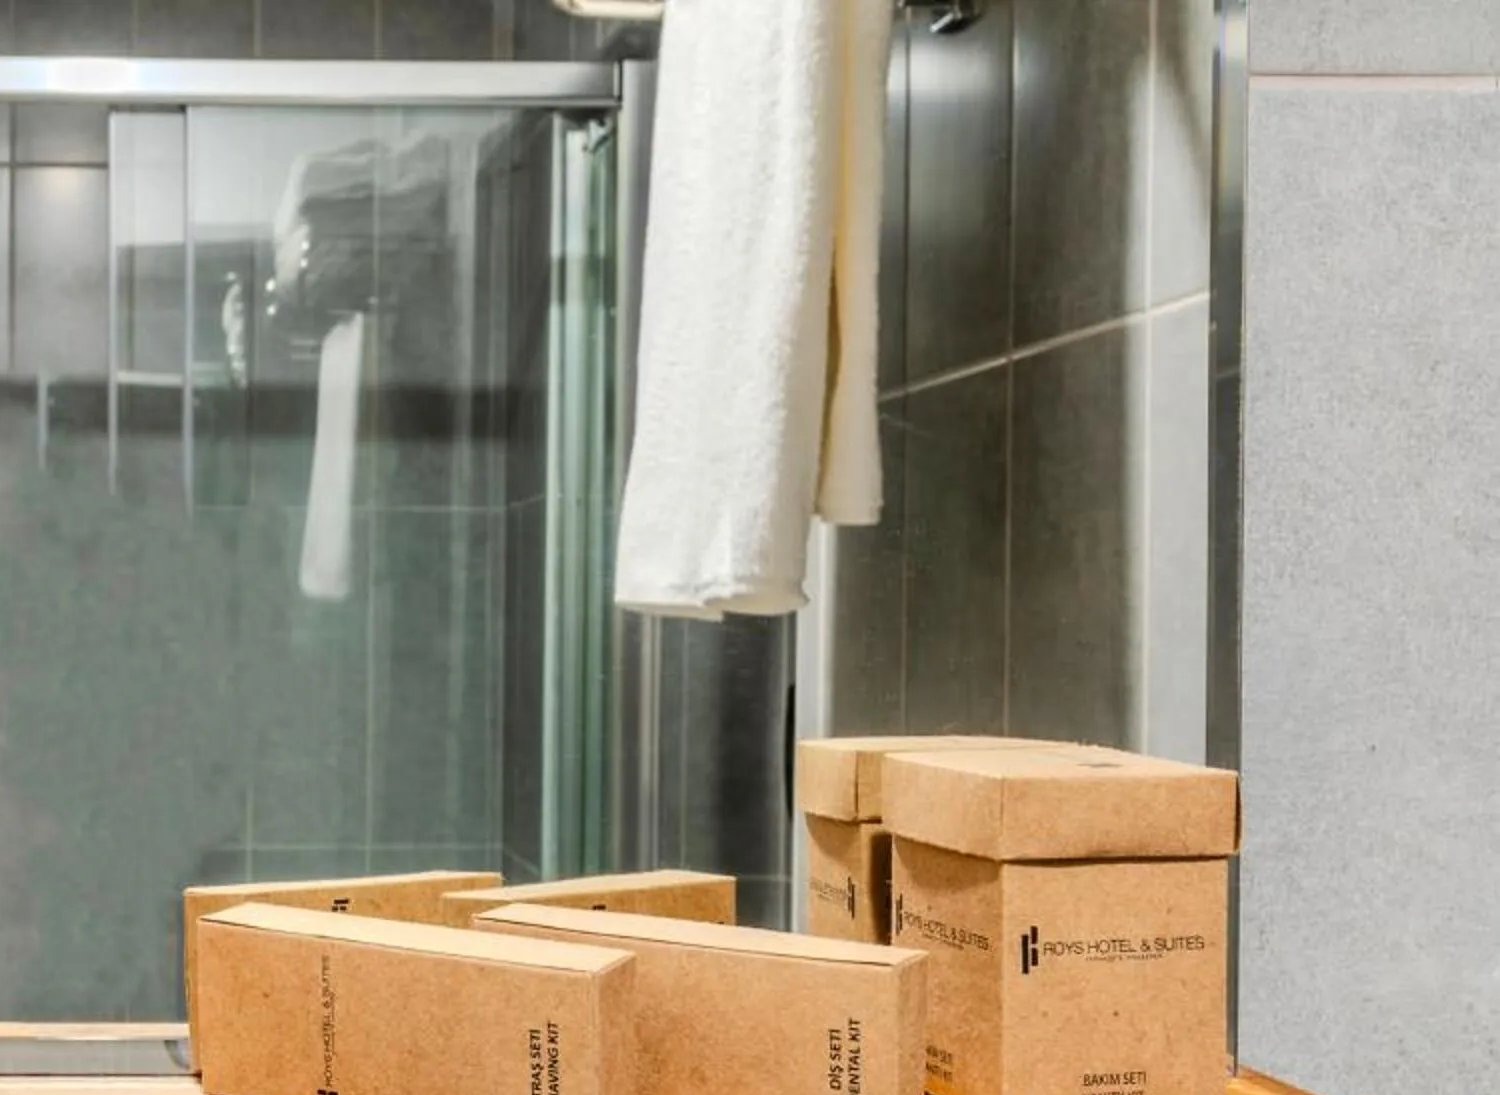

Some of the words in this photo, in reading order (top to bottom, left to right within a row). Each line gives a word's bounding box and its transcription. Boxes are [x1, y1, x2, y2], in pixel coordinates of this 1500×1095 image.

[1043, 940, 1085, 957] ROYS
[1087, 938, 1137, 954] HOTEL
[1139, 938, 1151, 953] &
[1153, 934, 1206, 952] SUITES
[547, 1020, 560, 1045] KIT
[848, 1017, 861, 1042] KIT
[1082, 1073, 1121, 1087] BAKIM
